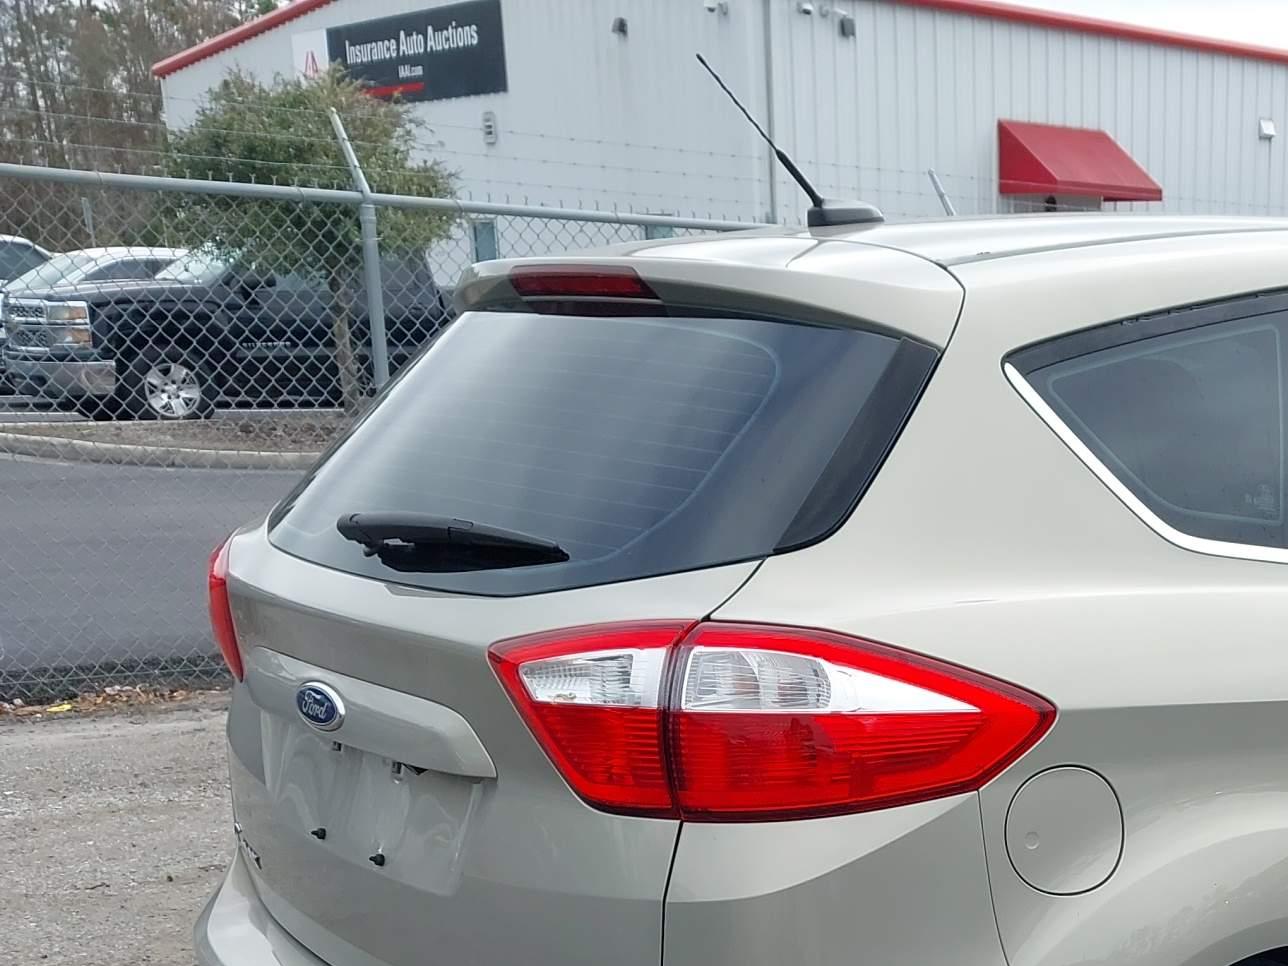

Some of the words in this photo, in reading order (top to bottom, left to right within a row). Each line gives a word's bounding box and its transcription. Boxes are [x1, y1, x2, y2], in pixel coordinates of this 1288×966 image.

[345, 39, 397, 64] Insurance
[400, 30, 424, 56] Auto
[427, 21, 478, 51] Auctions
[301, 690, 332, 720] Ford
